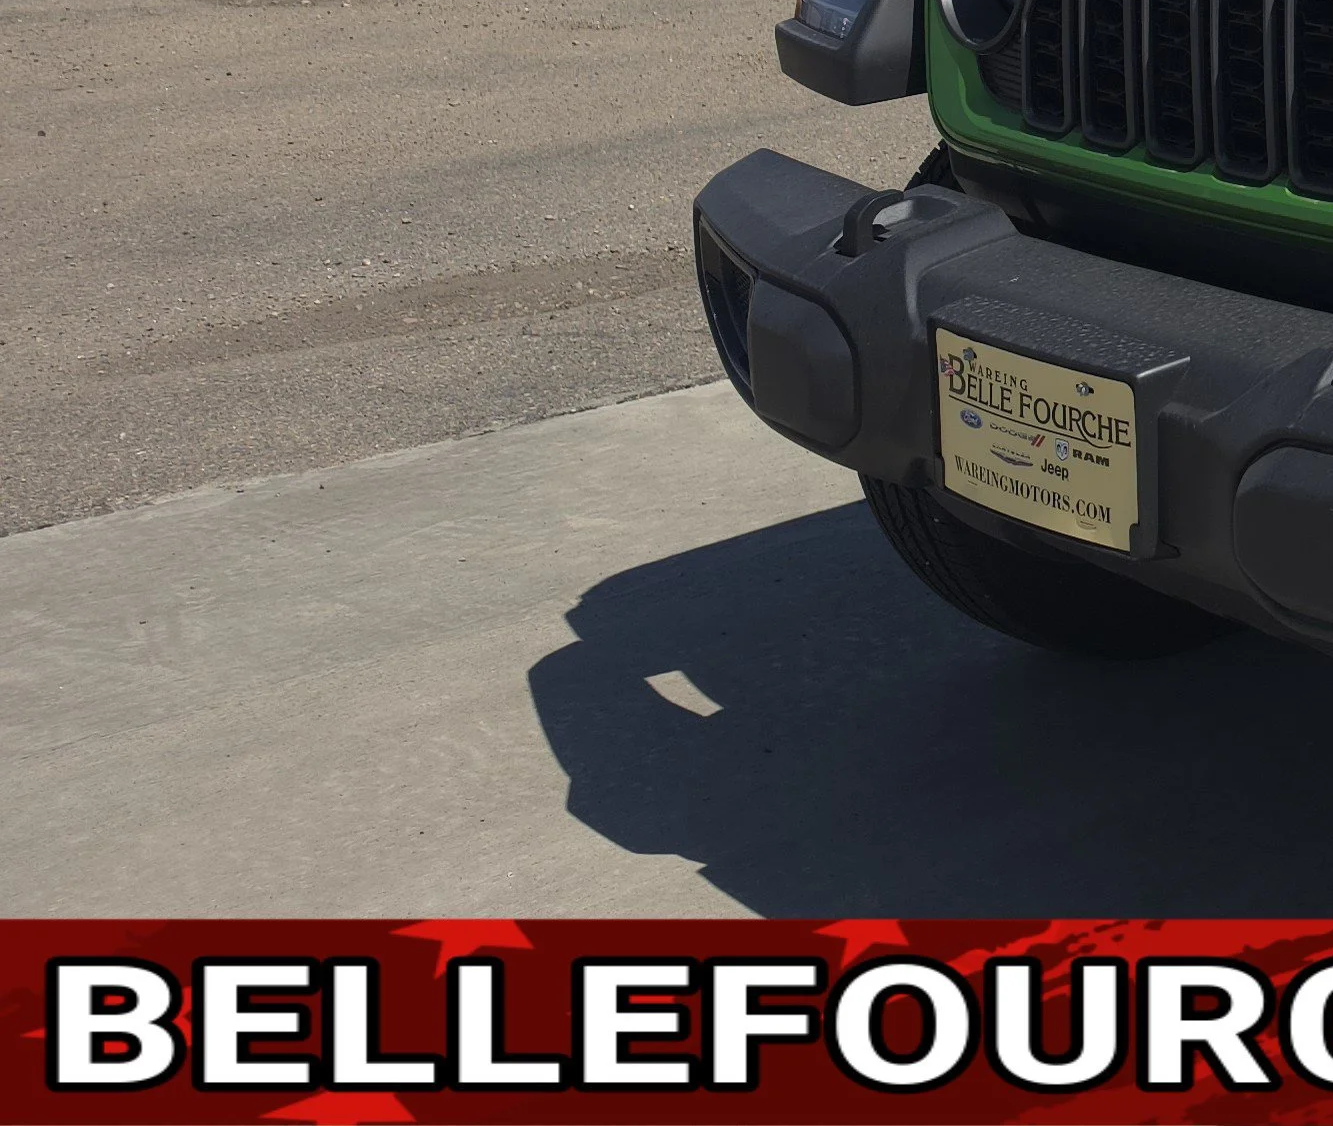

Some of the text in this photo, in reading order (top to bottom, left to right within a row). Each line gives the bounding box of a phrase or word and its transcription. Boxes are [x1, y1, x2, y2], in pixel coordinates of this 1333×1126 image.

[968, 358, 1029, 392] WAREING
[947, 353, 1132, 448] BELLE FOURCHE
[1040, 458, 1070, 481] Jeep
[1072, 448, 1110, 468] RAM
[954, 454, 1112, 525] WAREINGMOTORS.COM
